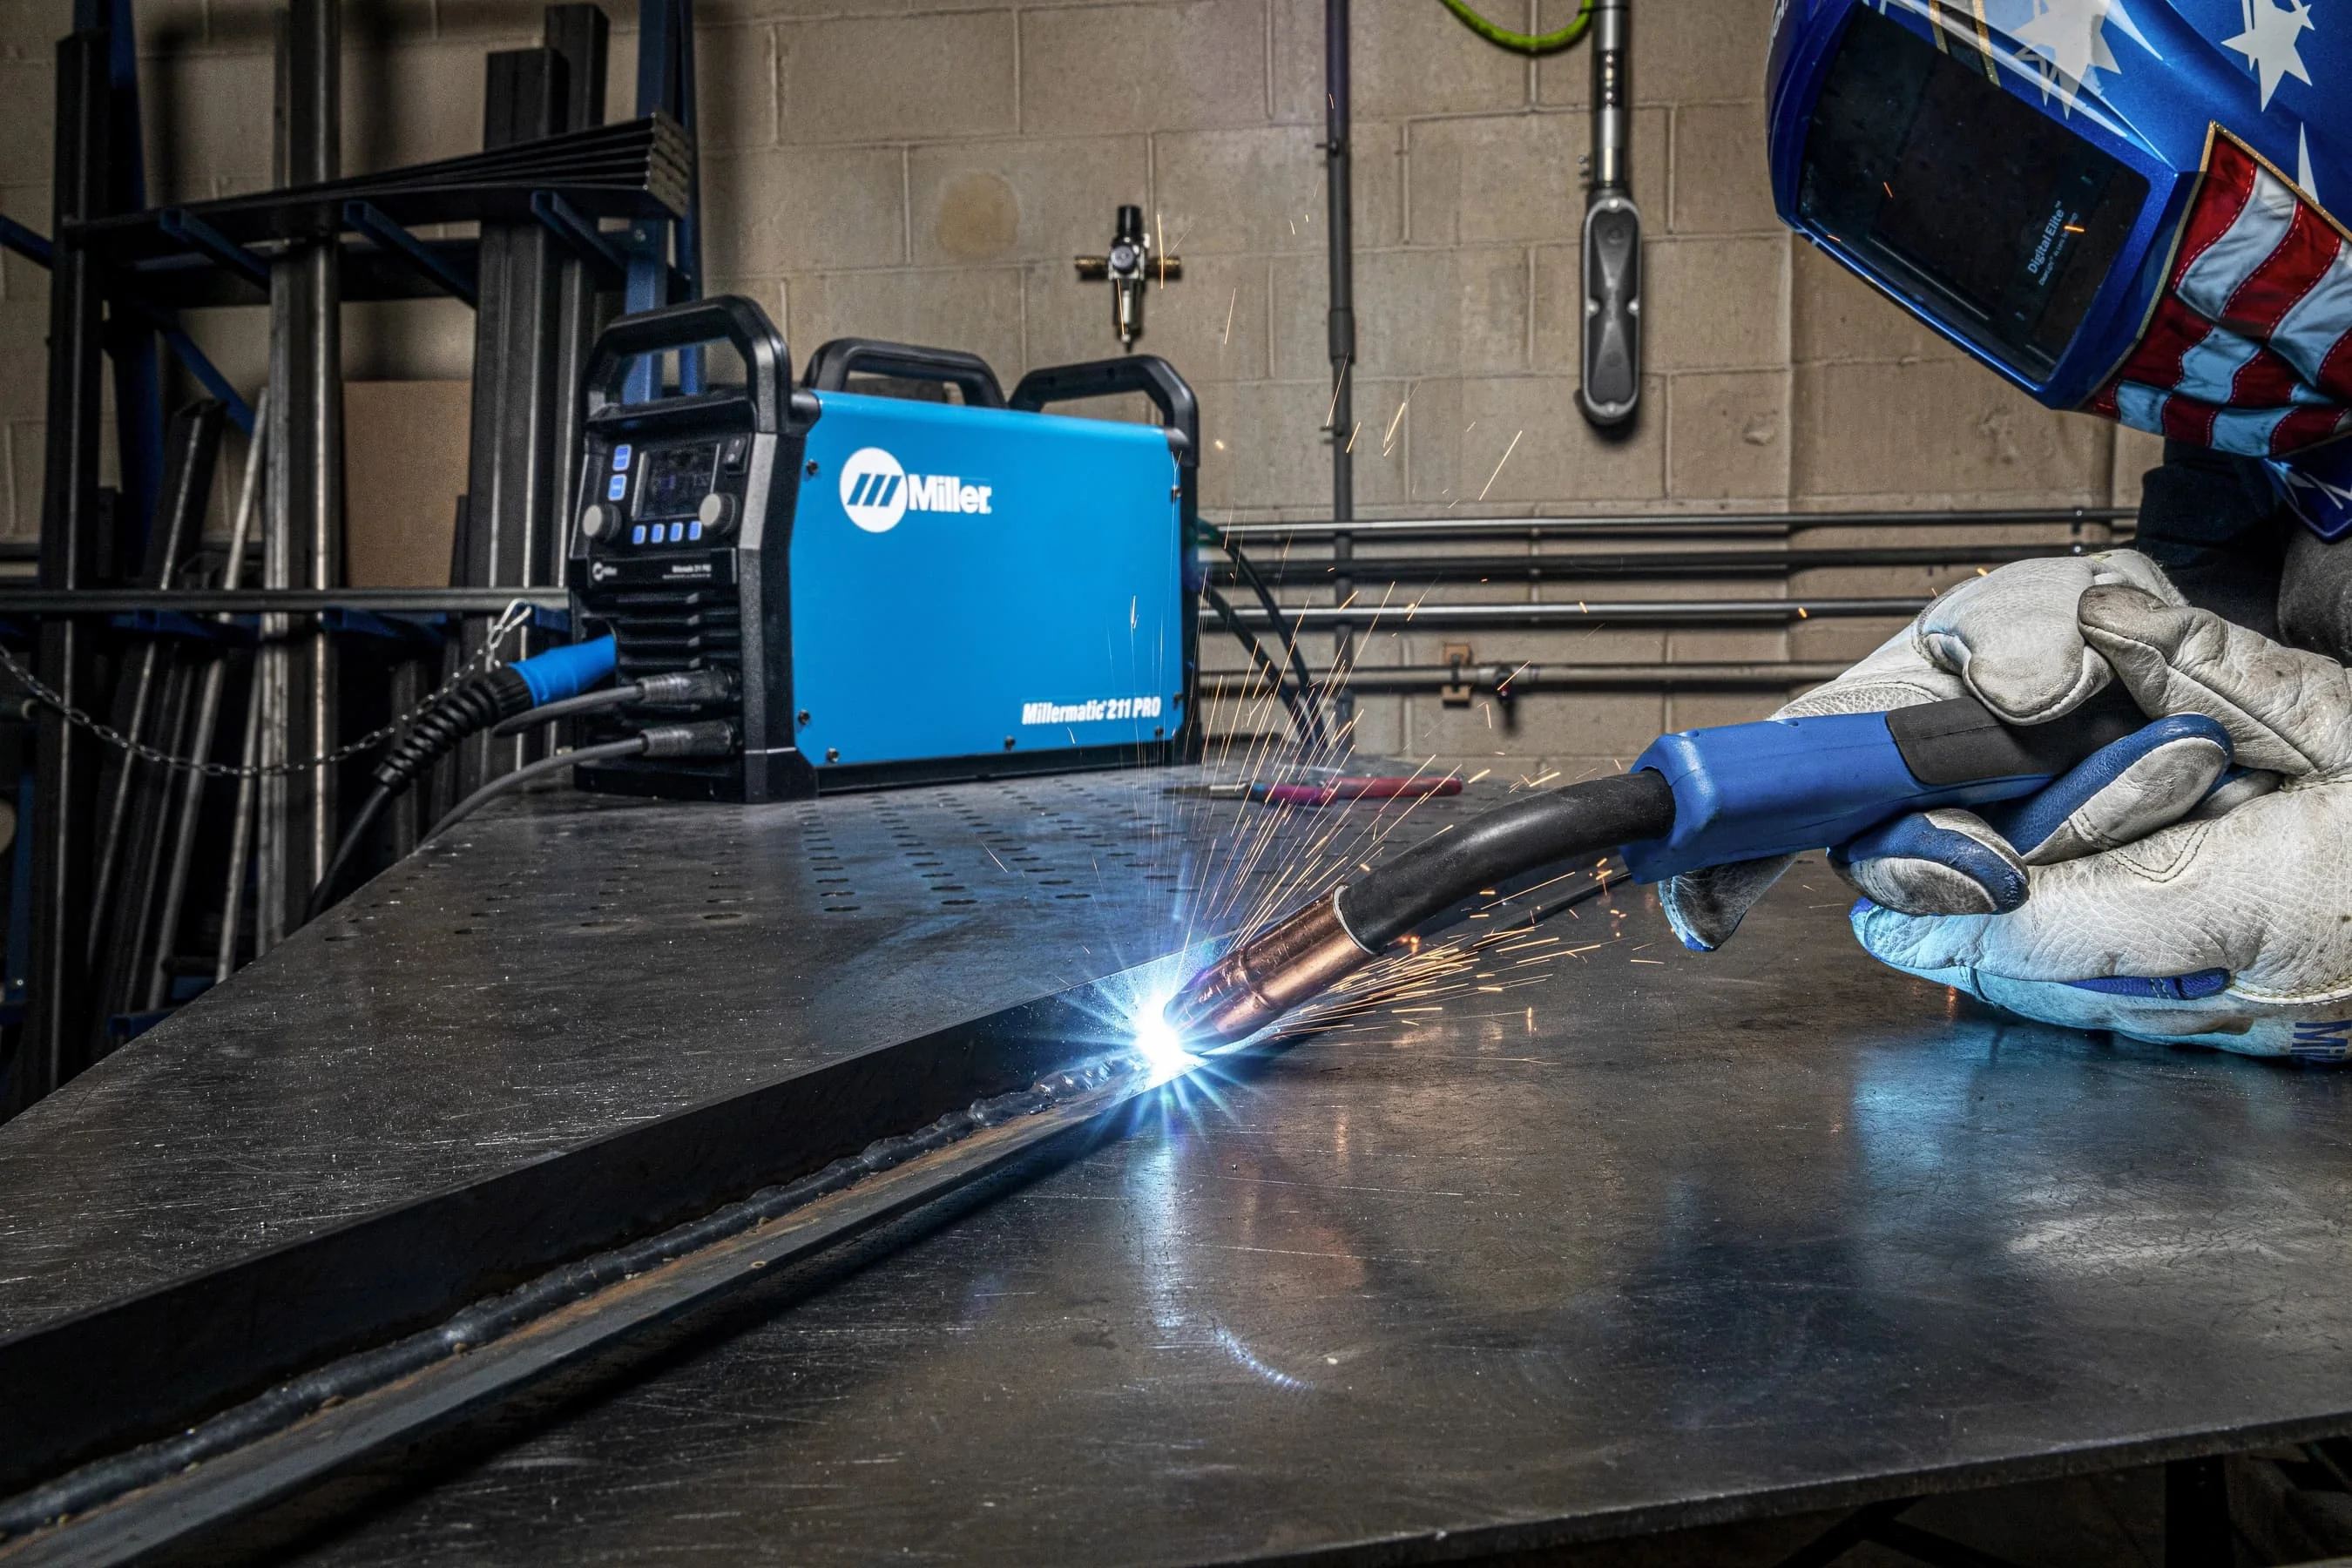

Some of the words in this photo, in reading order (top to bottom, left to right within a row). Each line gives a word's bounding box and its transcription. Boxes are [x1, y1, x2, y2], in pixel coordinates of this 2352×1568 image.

[2027, 234, 2052, 274] Digital
[908, 474, 992, 514] Miller
[1106, 698, 1132, 720] 211
[1132, 696, 1162, 719] PRO
